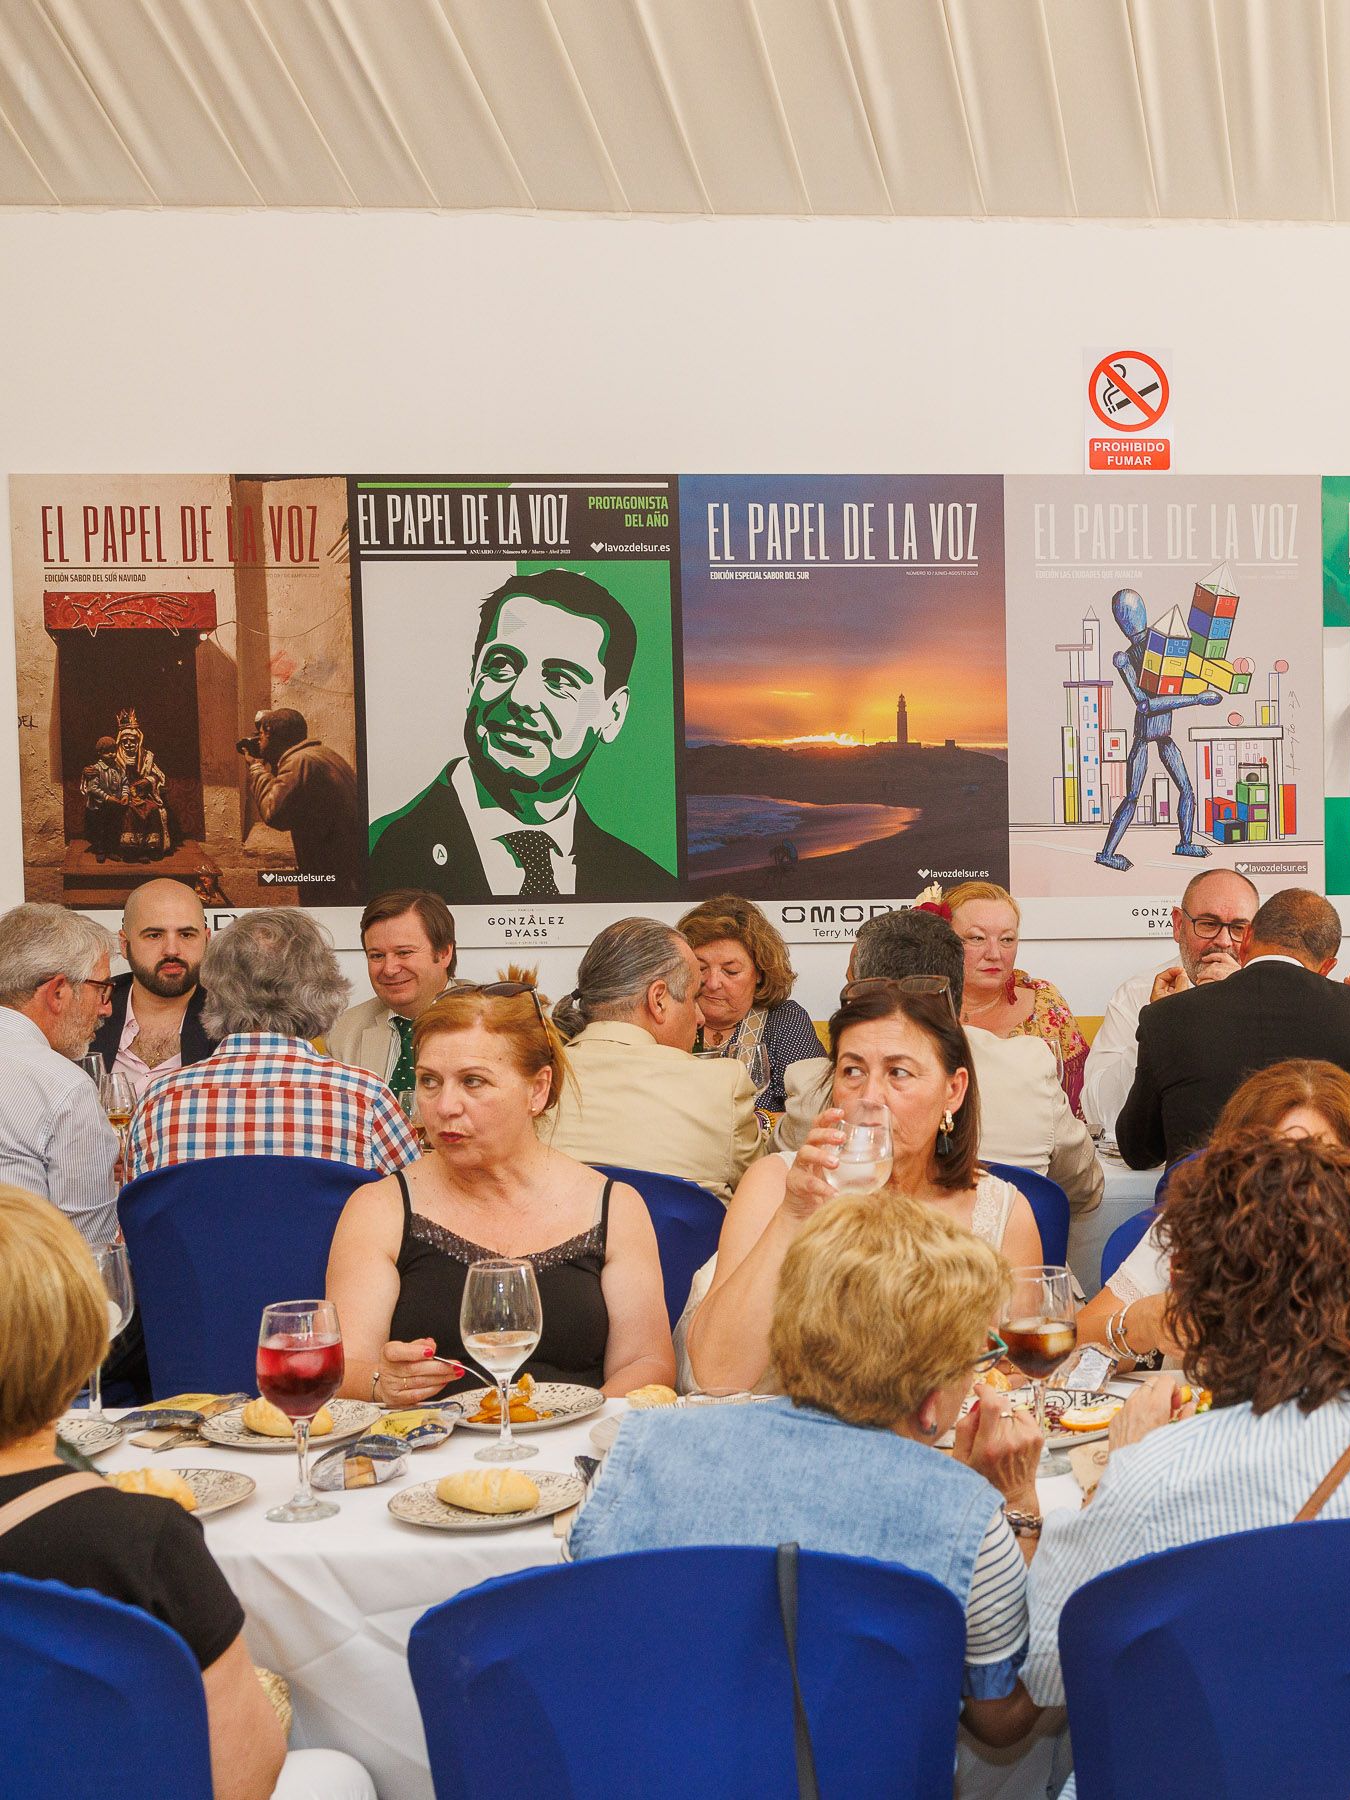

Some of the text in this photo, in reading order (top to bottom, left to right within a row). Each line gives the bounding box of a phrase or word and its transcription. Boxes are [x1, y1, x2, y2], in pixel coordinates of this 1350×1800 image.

[1094, 442, 1165, 452] PROHIBIDO
[1107, 456, 1152, 465] FUMAR
[588, 496, 669, 510] PROTAGONISTA
[357, 494, 569, 545] EL PAPEL DE LA VOZ
[624, 511, 669, 527] DEL AÑO
[41, 505, 319, 563] EL PAPEL DE LA VOZ
[707, 503, 979, 561] EL PAPEL DE LA VOZ
[1034, 503, 1298, 560] EL PAPEL DE LA VOZ
[605, 542, 671, 552] lavozdelsur.es
[44, 572, 146, 582] EDICIÓN SABOR DEL SUR NAVIDAD
[710, 569, 809, 580] EDICIÓN ESPECIAL SABOR DEL SUR
[1036, 569, 1058, 579] EDICIÓN
[930, 868, 989, 879] lavozdelsur.es
[1249, 864, 1307, 873] lavozdelsur.es
[275, 873, 336, 883] lavozdelsur.es
[782, 905, 912, 923] OMOD
[1132, 908, 1173, 916] GONZ
[1148, 920, 1173, 928] BYA
[505, 929, 548, 937] BYASS
[813, 928, 841, 938] Terry
